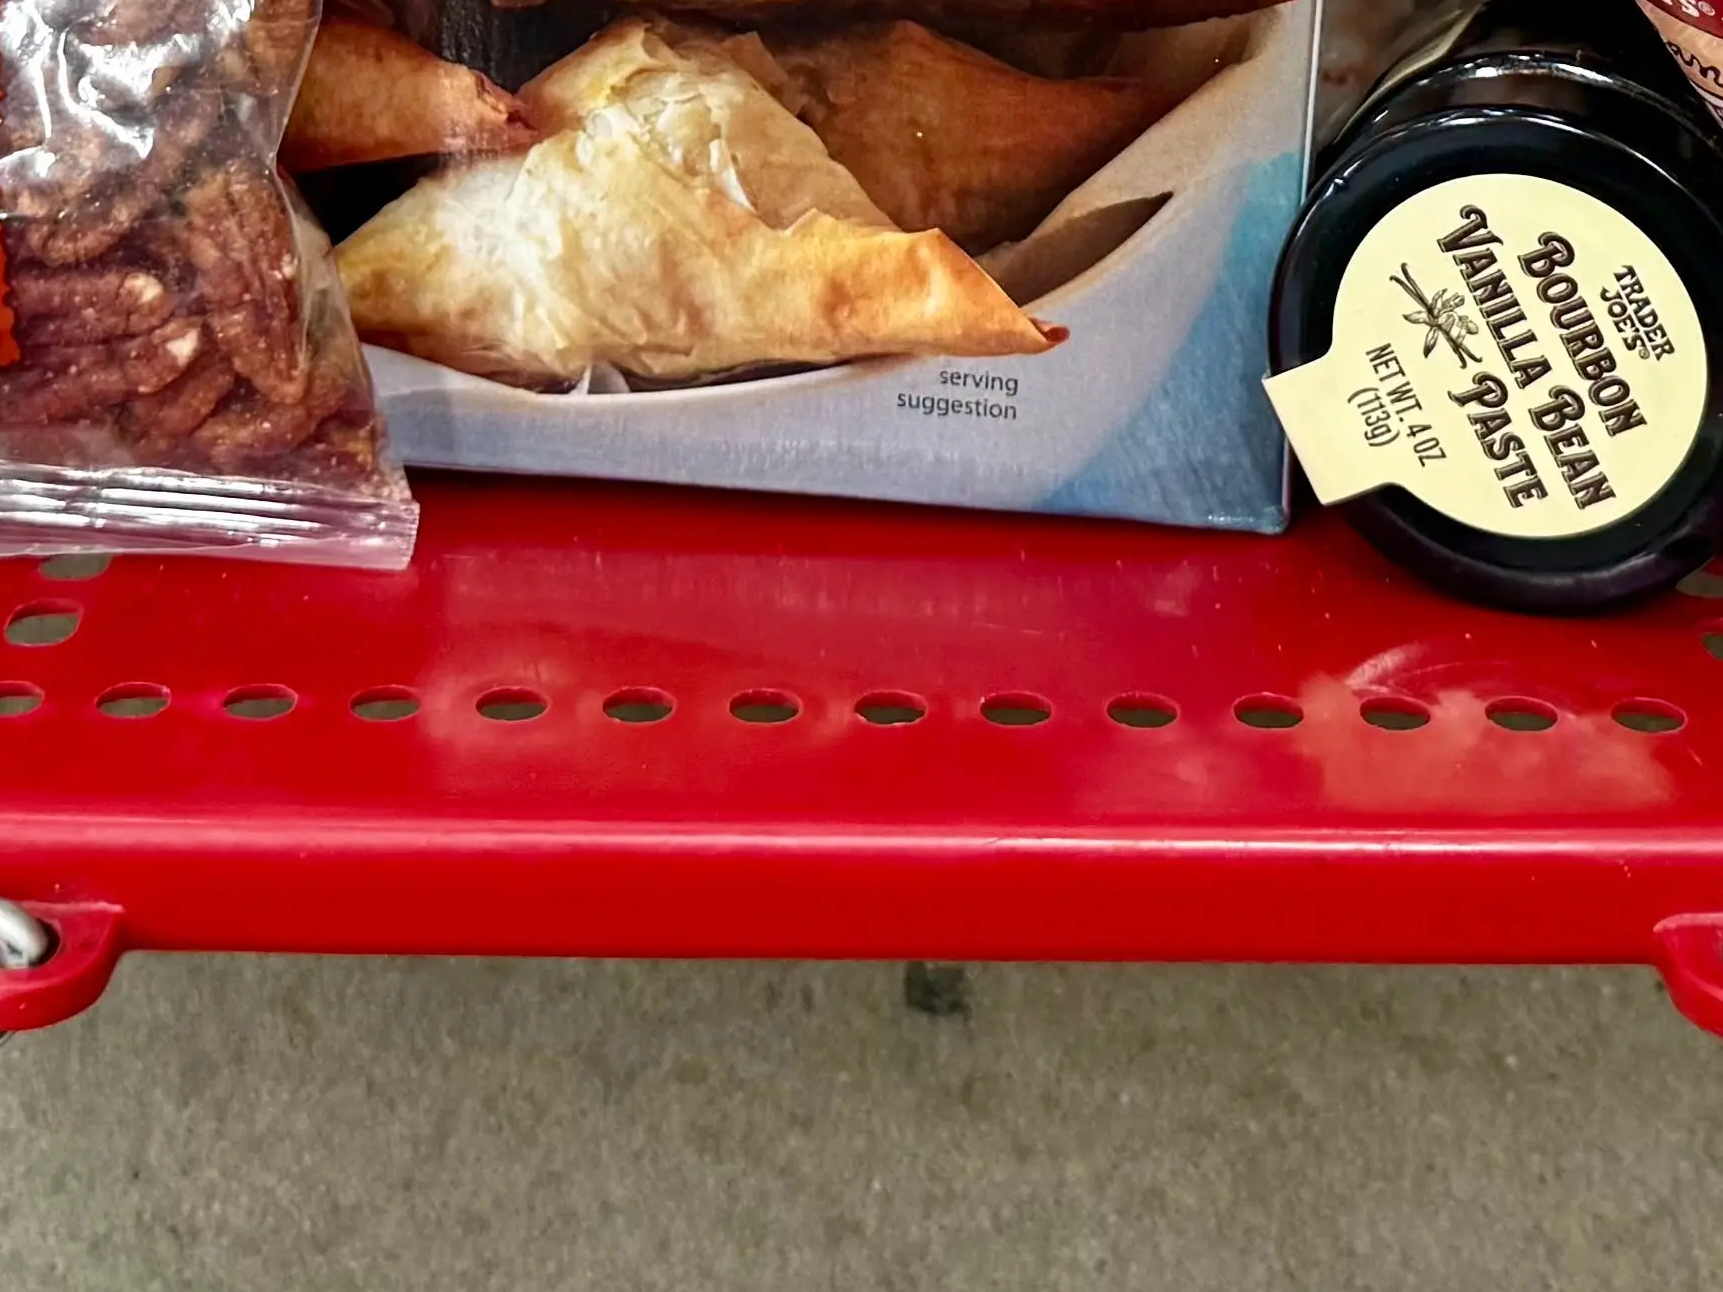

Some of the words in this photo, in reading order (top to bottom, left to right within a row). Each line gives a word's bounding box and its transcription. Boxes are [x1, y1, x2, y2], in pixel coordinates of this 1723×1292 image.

[1516, 231, 1649, 438] BOURBON
[1599, 285, 1643, 352] JOE'S
[1612, 264, 1675, 362] TRADER
[939, 369, 1019, 397] serving
[1365, 342, 1406, 383] NET
[1436, 204, 1554, 390] VANILLA
[1527, 384, 1617, 510] BEAN
[897, 391, 1018, 420] suggestion
[1346, 386, 1402, 448] (113g)
[1384, 379, 1423, 423] WT.
[1405, 420, 1433, 439] 4
[1412, 435, 1447, 468] OZ
[1446, 370, 1549, 509] PASTE
